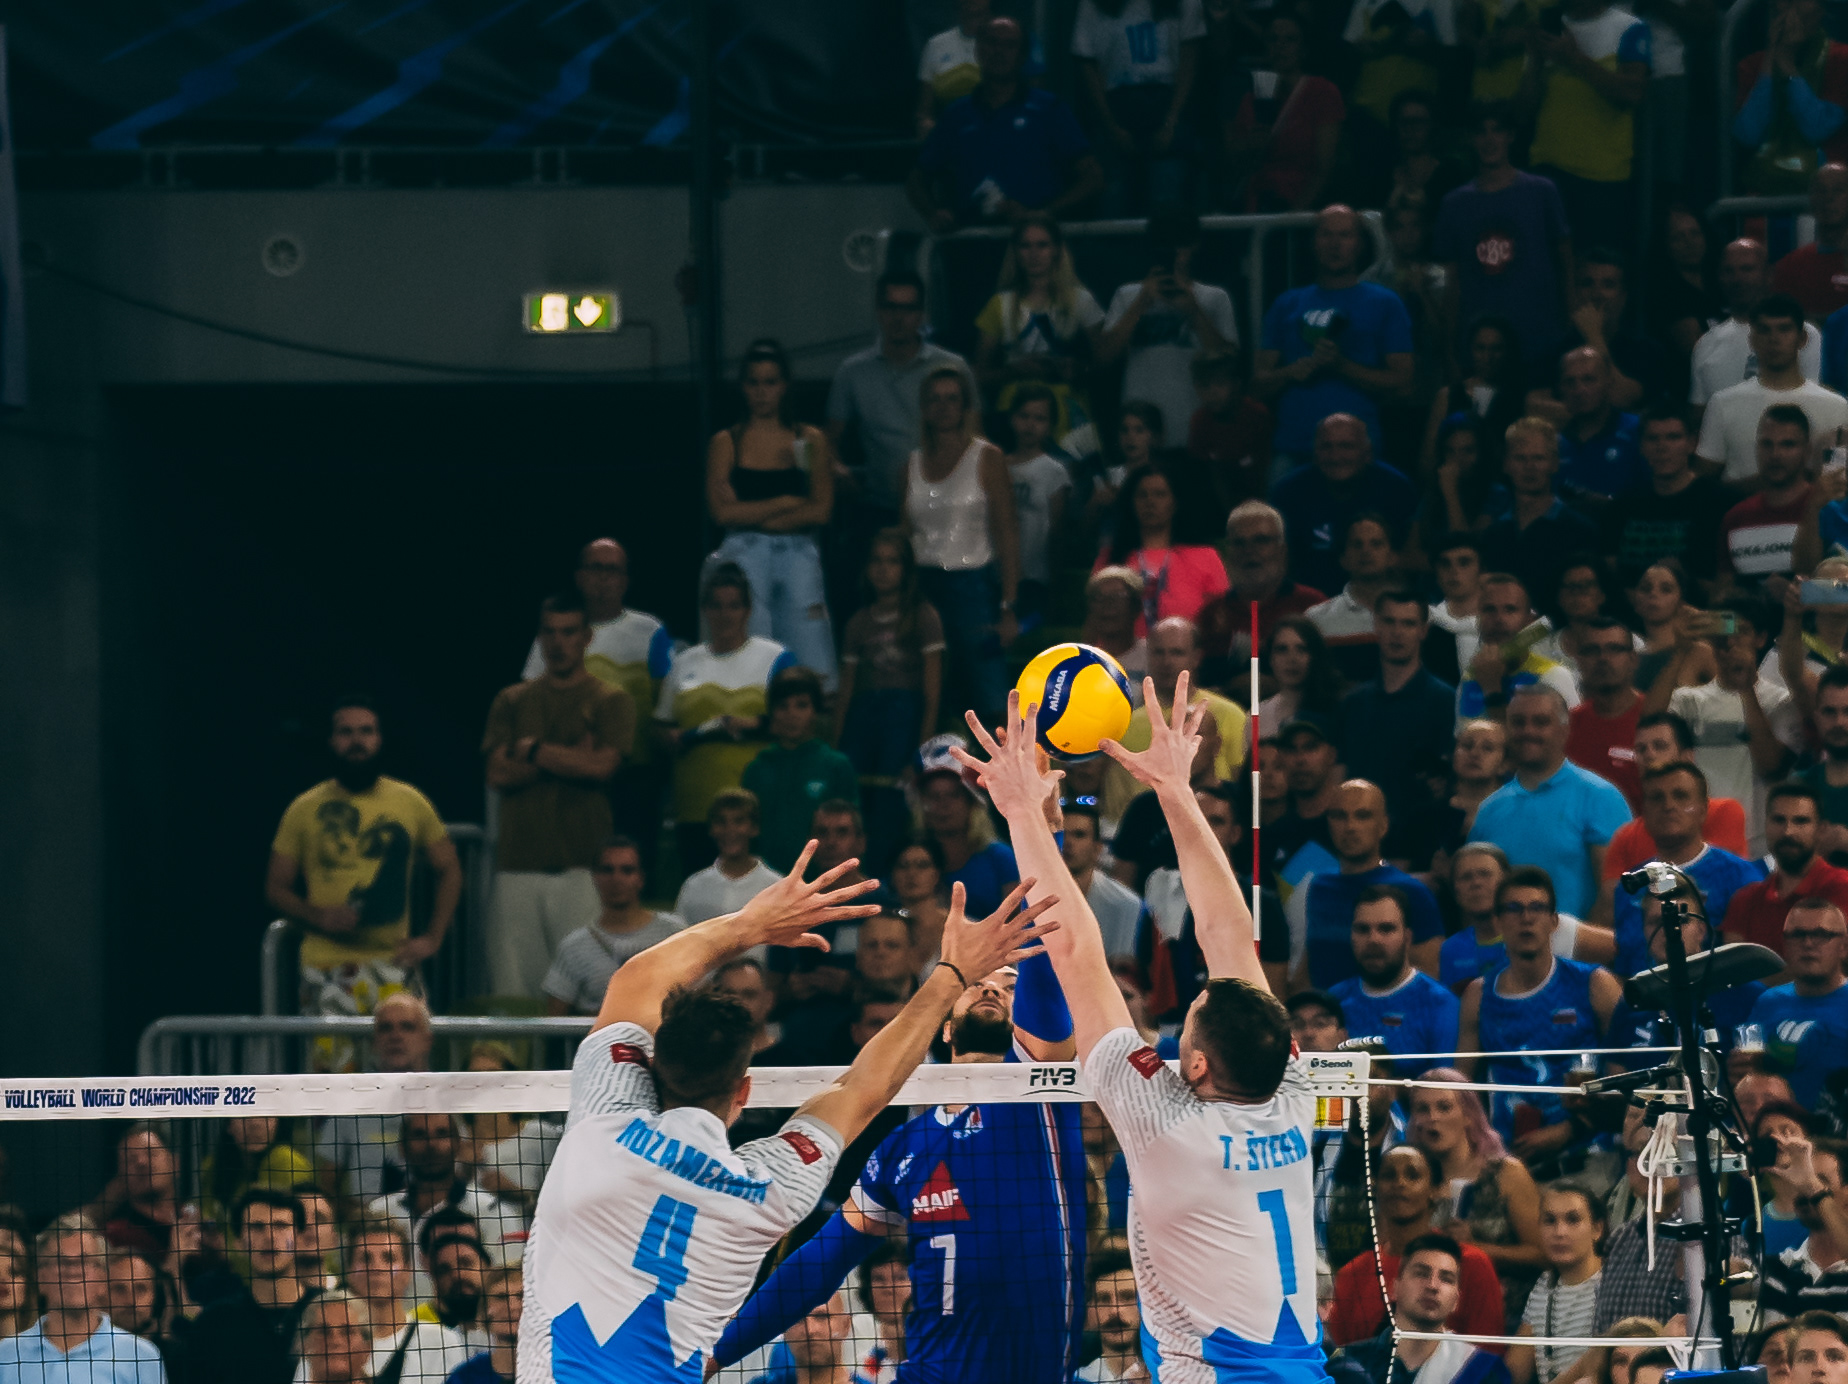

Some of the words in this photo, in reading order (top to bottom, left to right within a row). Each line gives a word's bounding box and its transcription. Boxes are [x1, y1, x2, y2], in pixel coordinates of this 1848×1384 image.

[1029, 1067, 1077, 1087] FIVB
[1320, 1059, 1353, 1069] Senoh
[5, 1089, 76, 1109] VOLLEYBALL
[81, 1088, 127, 1108] WORLD
[129, 1087, 220, 1107] CHAMPIONSHIP
[224, 1086, 257, 1106] 2022
[1218, 1134, 1241, 1171] T.
[911, 1188, 959, 1216] MAIF
[632, 1194, 698, 1302] 4
[1256, 1188, 1298, 1297] 1
[929, 1233, 956, 1316] 7
